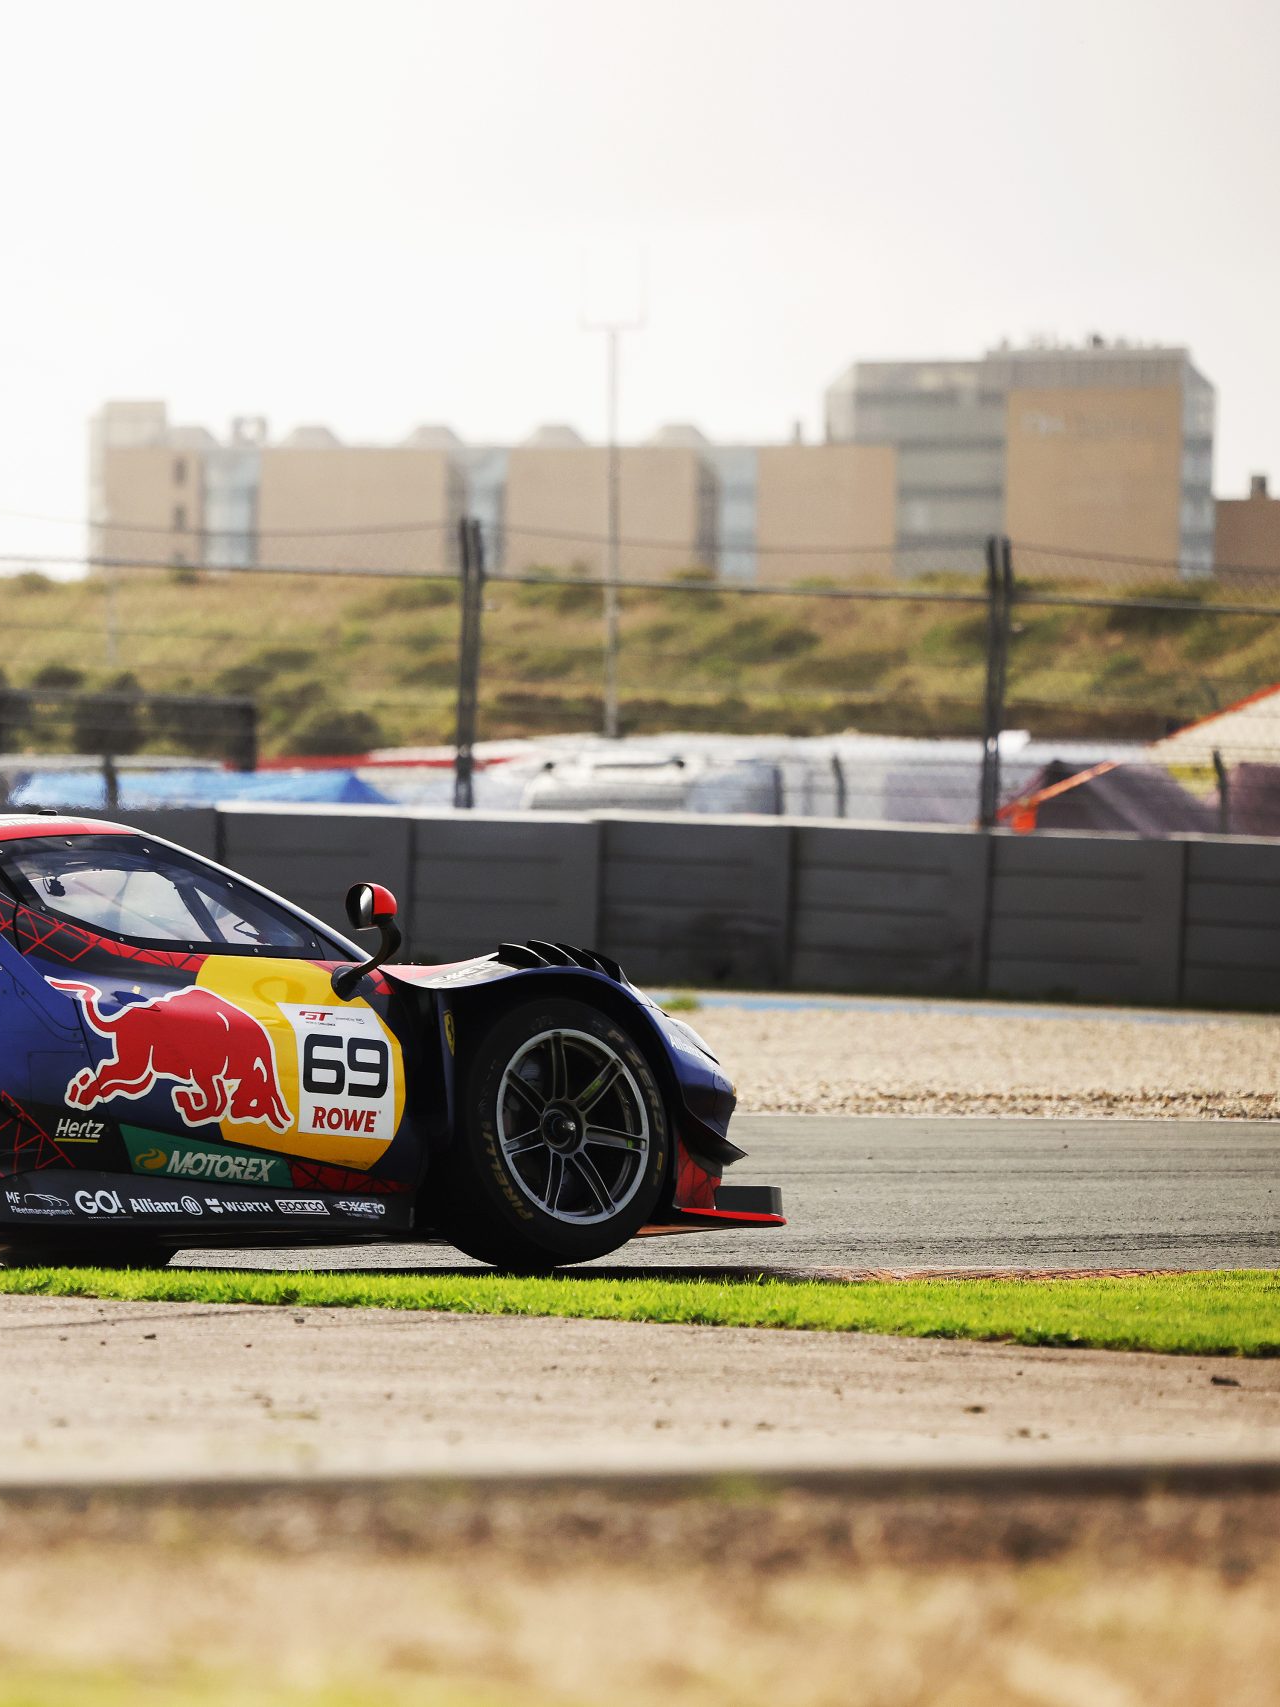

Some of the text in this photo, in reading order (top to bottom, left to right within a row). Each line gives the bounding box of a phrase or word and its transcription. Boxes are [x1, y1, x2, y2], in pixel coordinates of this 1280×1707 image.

[302, 1033, 389, 1099] 69
[55, 1118, 105, 1138] Hertz
[312, 1105, 377, 1133] ROWE
[166, 1150, 276, 1182] MOTOREX
[5, 1191, 21, 1204] MF
[74, 1190, 127, 1214] GO!
[129, 1198, 183, 1214] Allianz
[222, 1201, 274, 1213] WÜRTH
[276, 1200, 326, 1214] sparco
